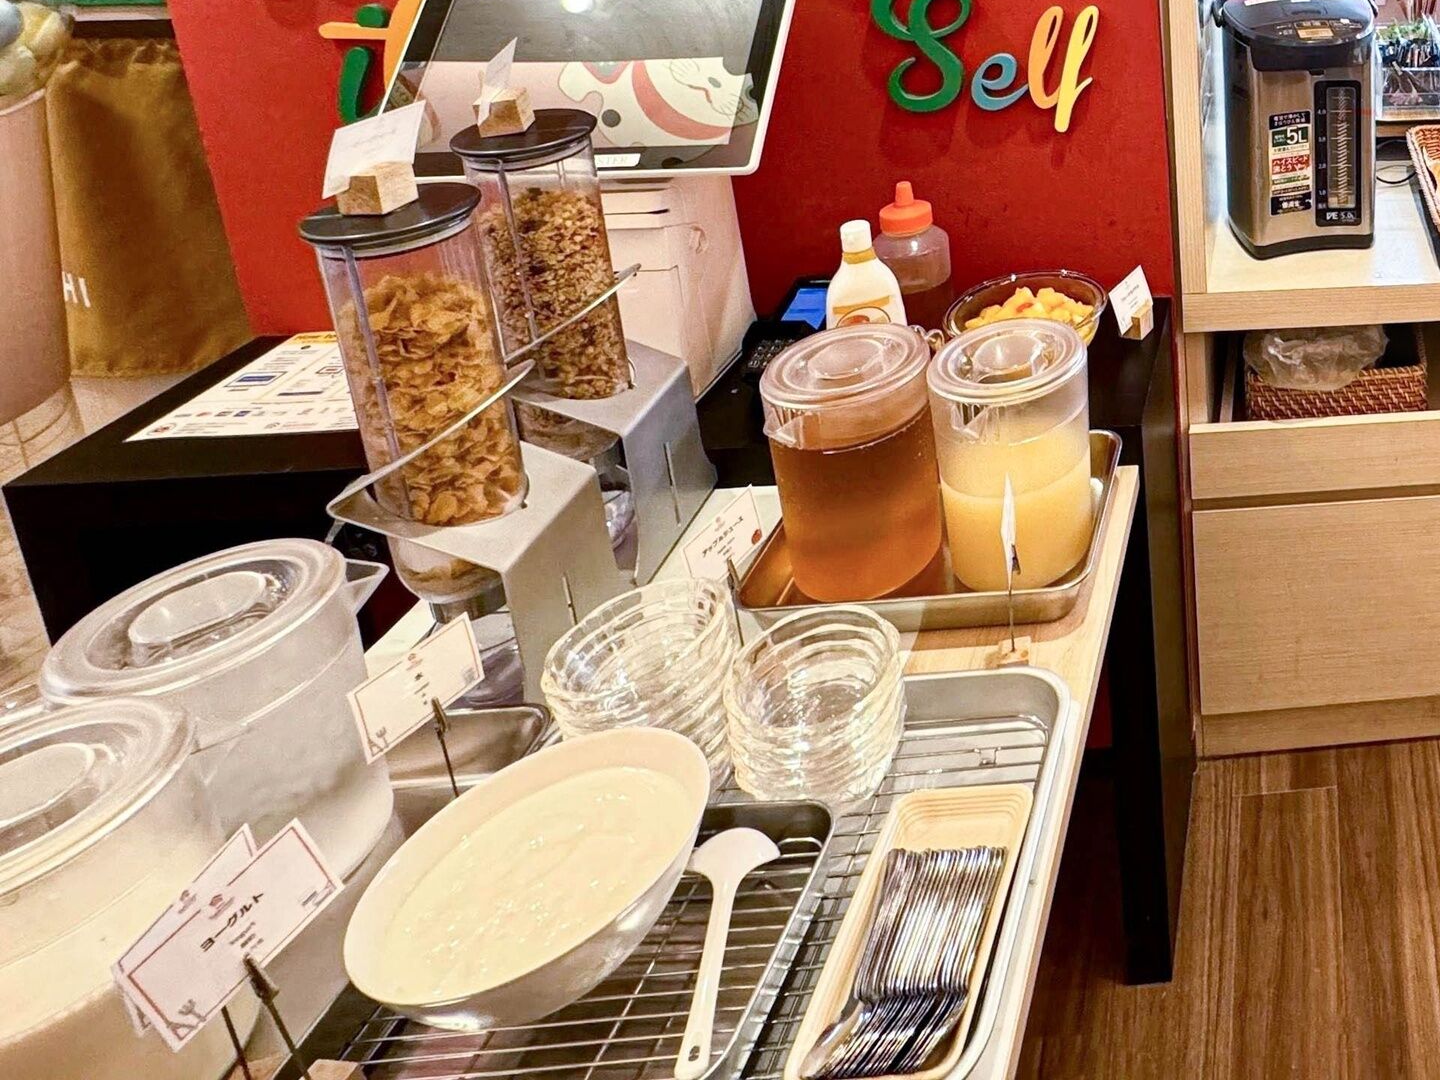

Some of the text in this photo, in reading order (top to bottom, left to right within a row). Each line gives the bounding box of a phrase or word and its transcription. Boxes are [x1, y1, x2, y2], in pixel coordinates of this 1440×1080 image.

[1286, 126, 1307, 145] 5L
[200, 892, 264, 953] ヨーグルト
